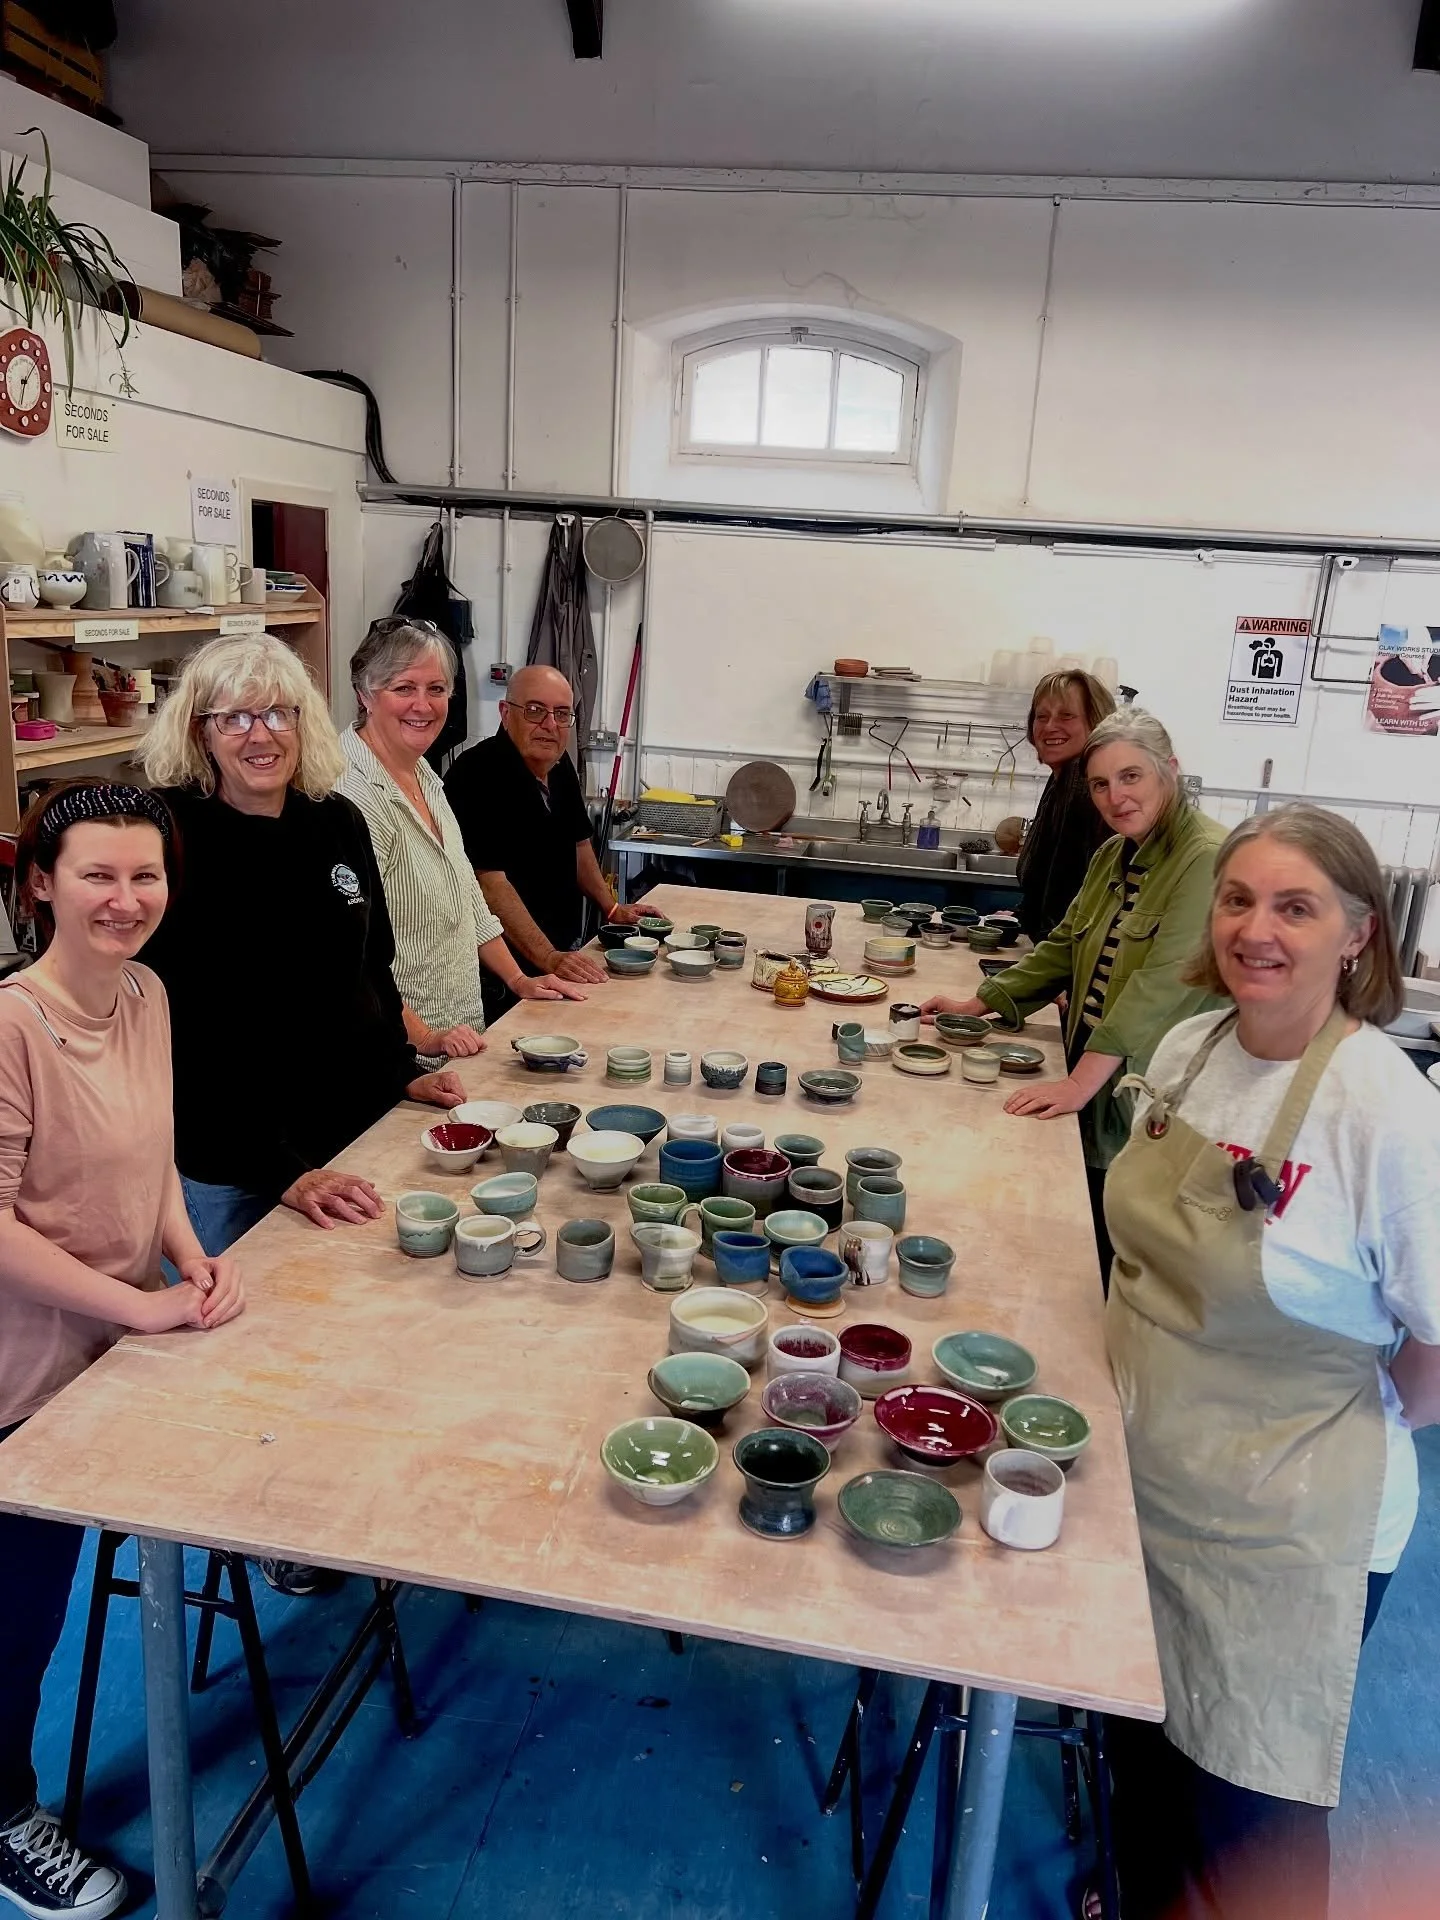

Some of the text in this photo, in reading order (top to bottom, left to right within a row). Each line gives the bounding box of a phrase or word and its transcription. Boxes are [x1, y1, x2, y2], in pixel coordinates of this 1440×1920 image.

[64, 403, 109, 422] SECONDS
[66, 424, 109, 442] FOR SALE
[197, 487, 230, 503] SECONDS
[198, 505, 231, 520] FOR SALE
[84, 628, 130, 637] SECONDS FOR SALE
[1252, 619, 1308, 633] WARNING
[1229, 685, 1295, 696] Dust Inhalation
[1228, 694, 1259, 703] Hazard
